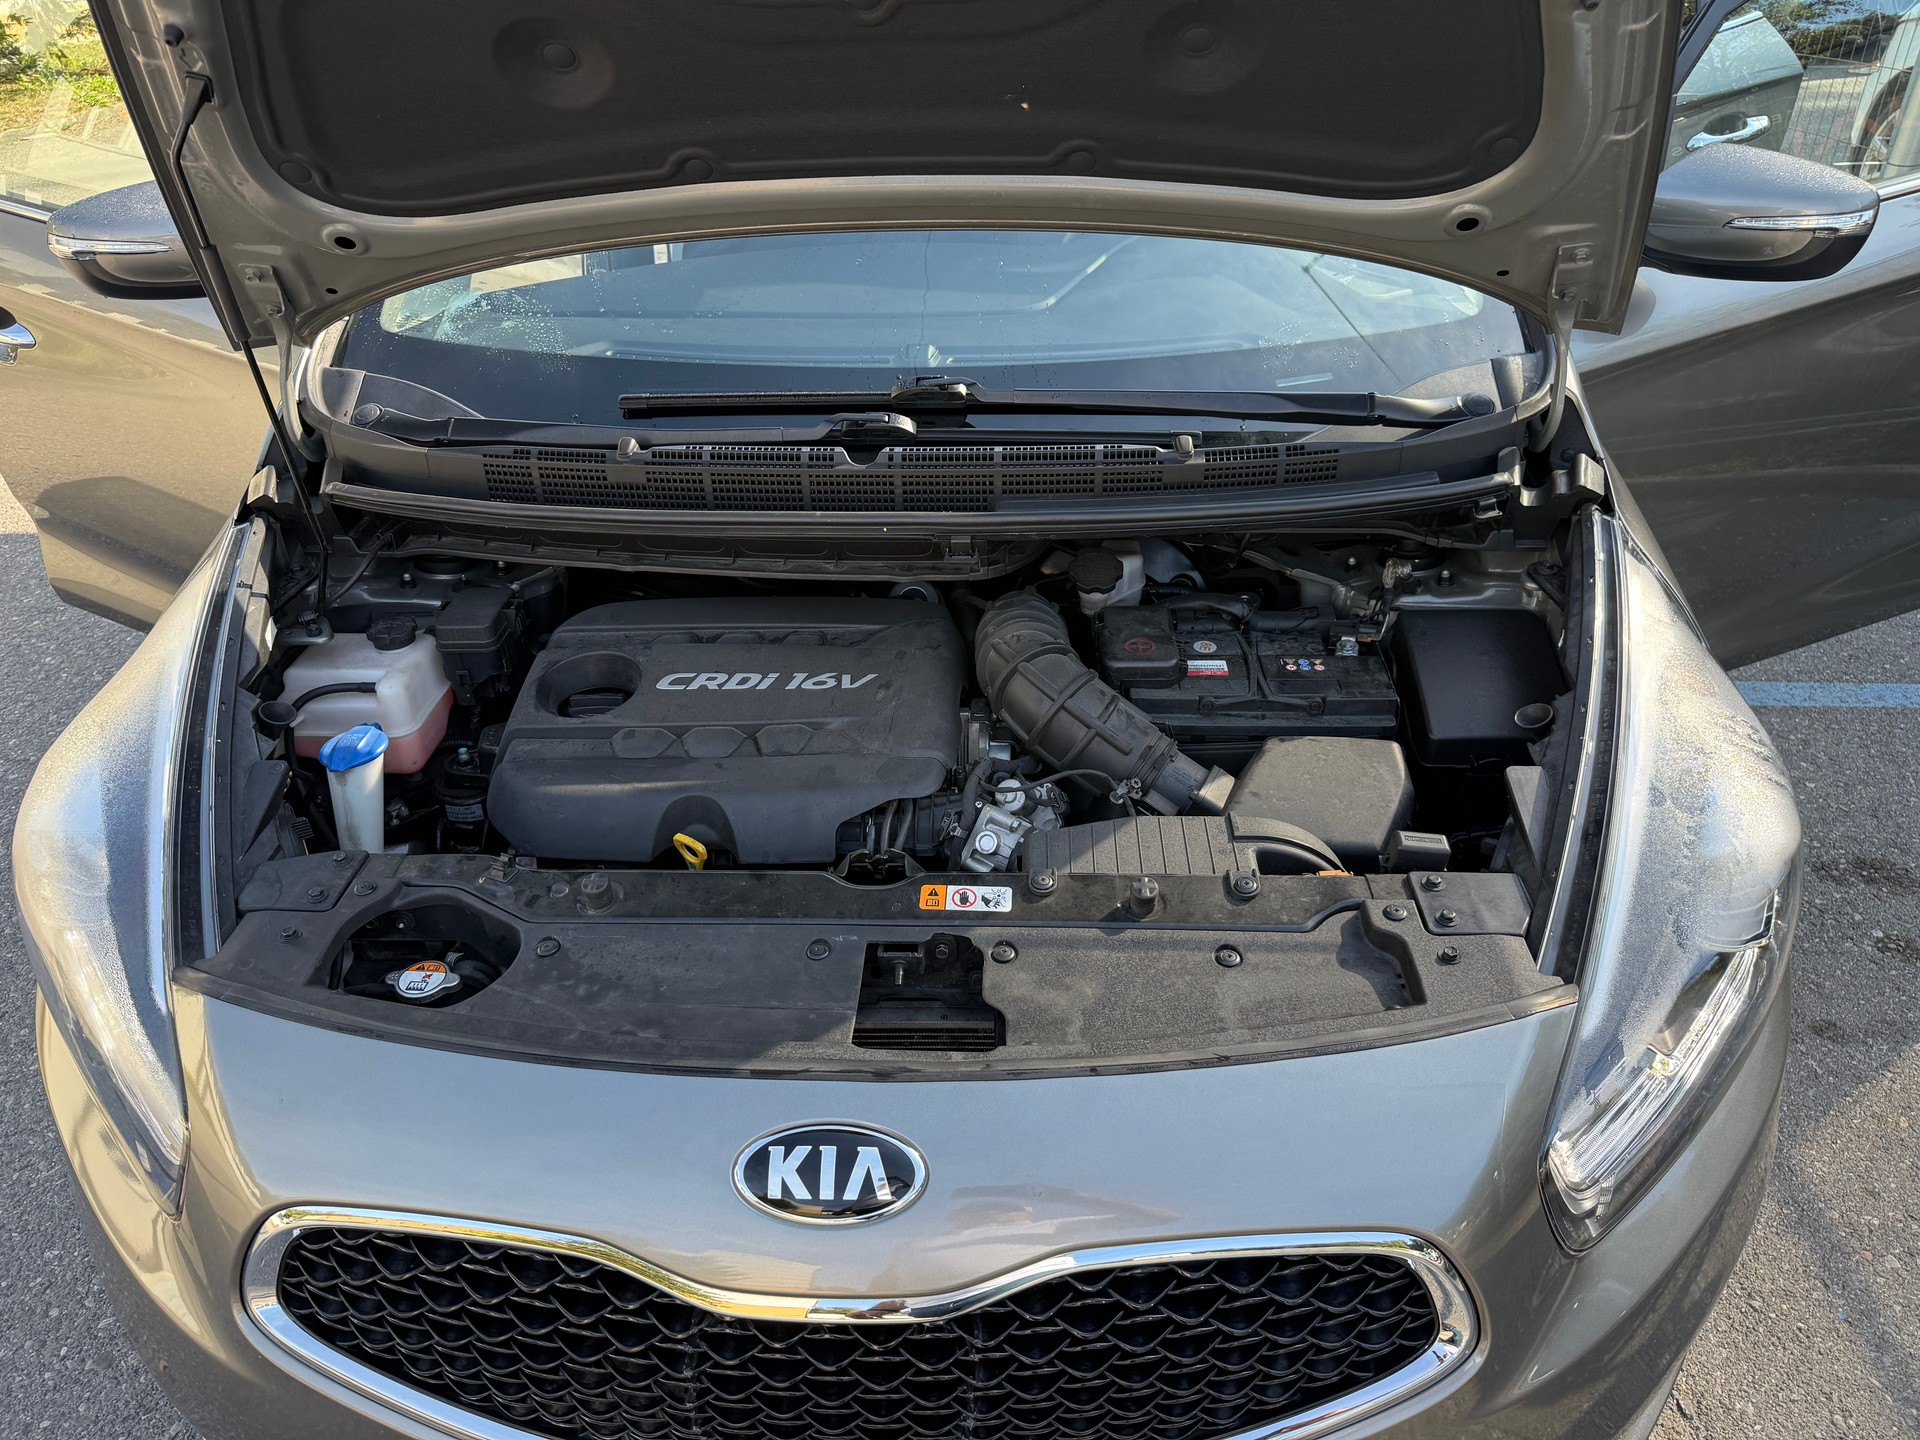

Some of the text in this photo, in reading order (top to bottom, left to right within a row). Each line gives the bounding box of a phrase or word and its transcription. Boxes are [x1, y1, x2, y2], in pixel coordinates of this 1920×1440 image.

[655, 672, 879, 690] CRDi 16V
[767, 1145, 893, 1201] KIA
